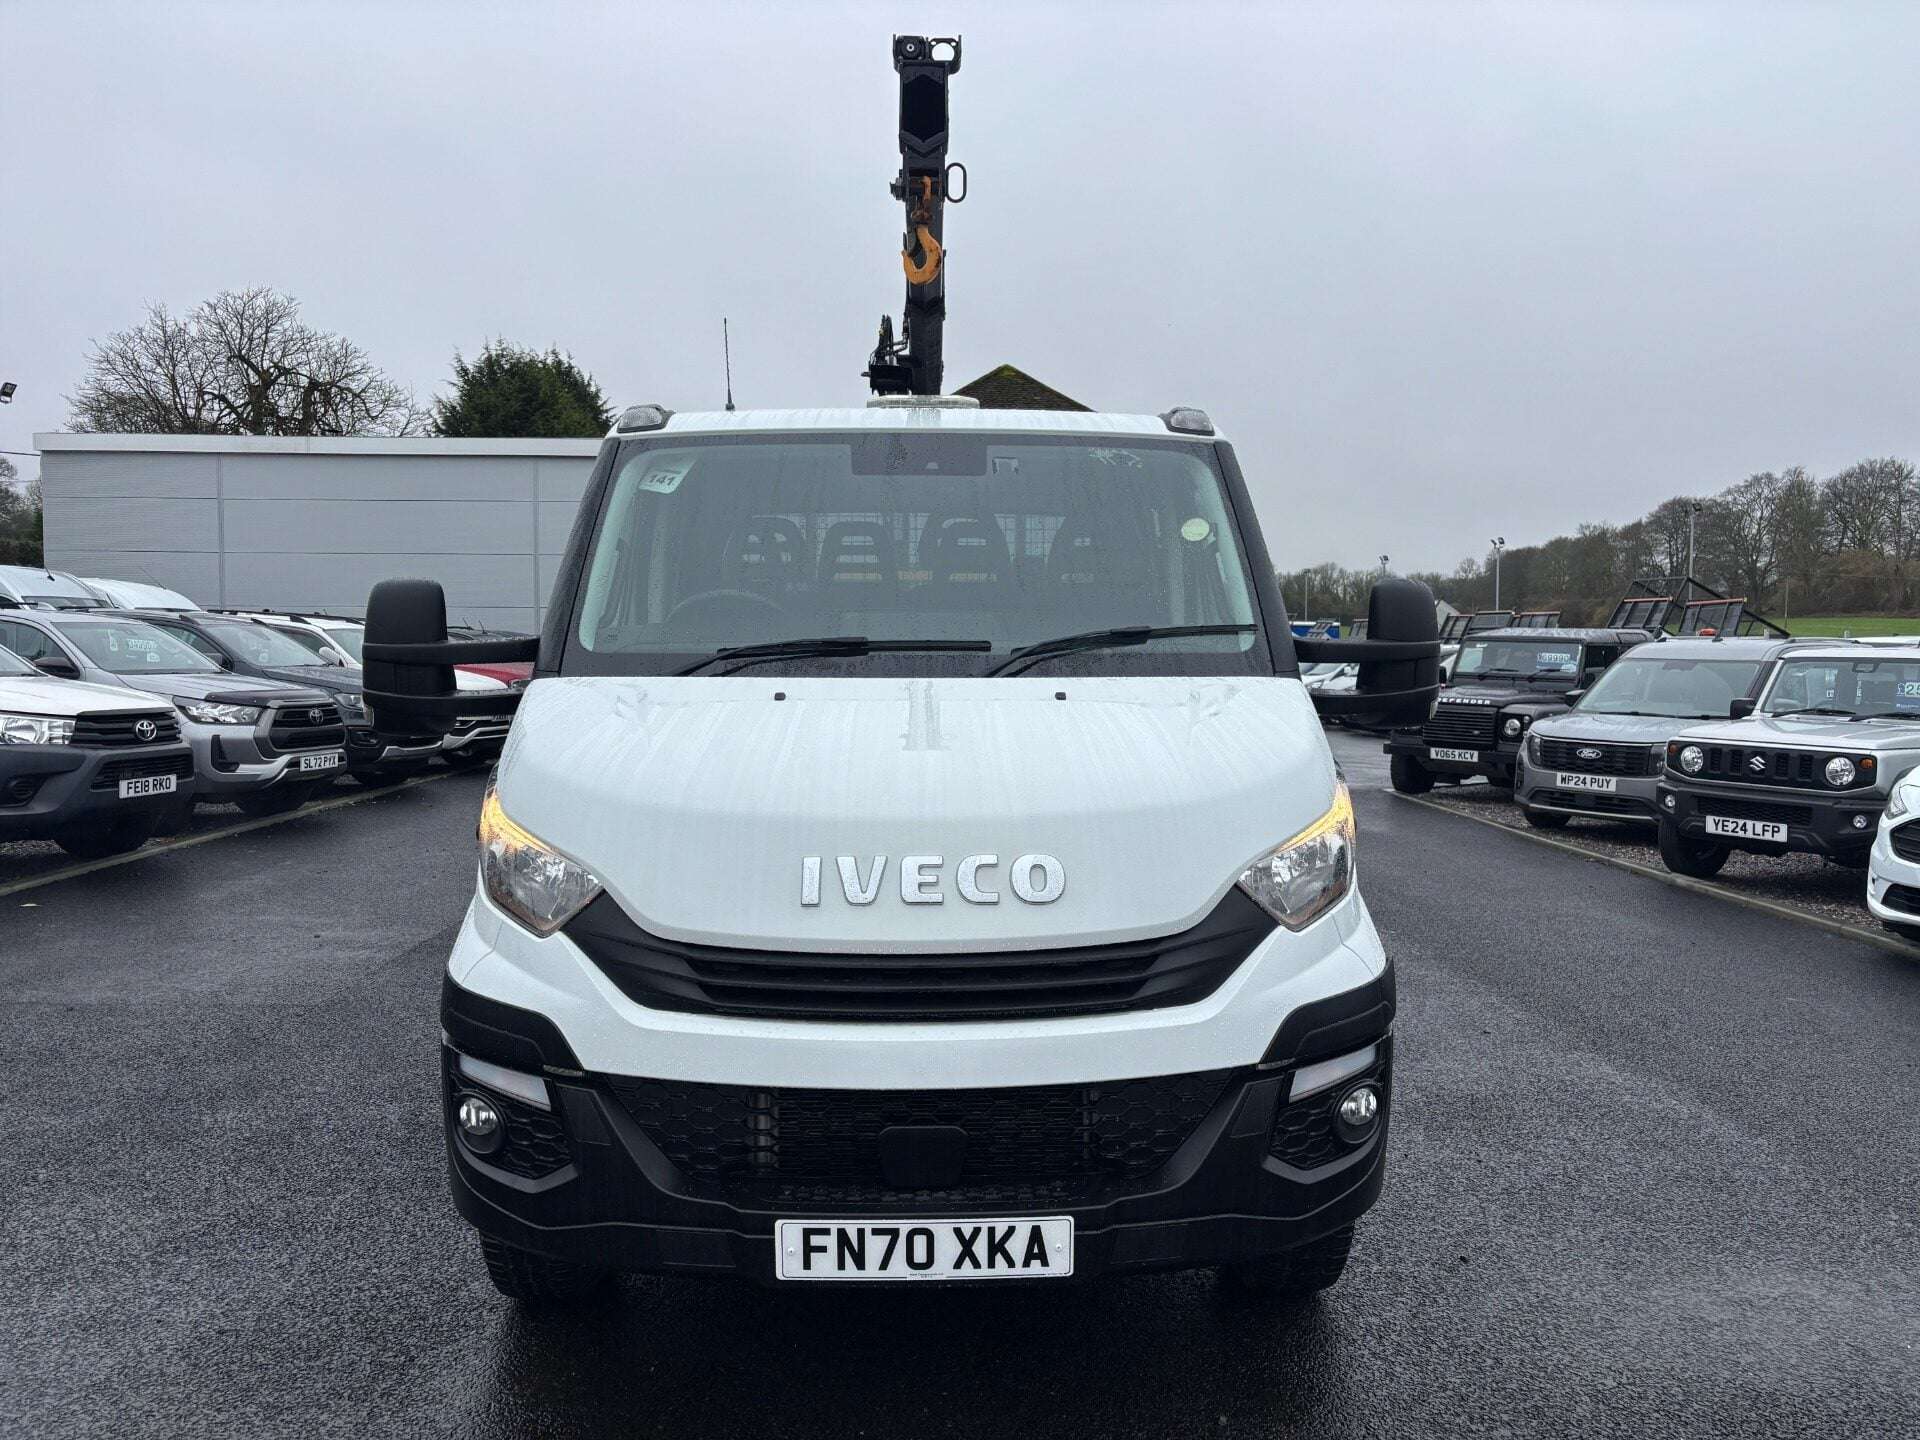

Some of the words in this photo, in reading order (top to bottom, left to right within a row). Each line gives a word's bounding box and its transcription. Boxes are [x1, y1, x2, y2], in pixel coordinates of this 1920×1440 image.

[303, 757, 322, 769] SL72
[127, 779, 150, 795] FE18
[152, 777, 171, 792] RKO
[1560, 774, 1587, 787] WP24
[1590, 777, 1611, 789] PUY
[1712, 817, 1748, 835] YE24
[1752, 822, 1780, 838] LFP
[801, 854, 1066, 906] IVECO
[802, 1227, 935, 1271] FN70
[952, 1225, 1050, 1270] XKA
